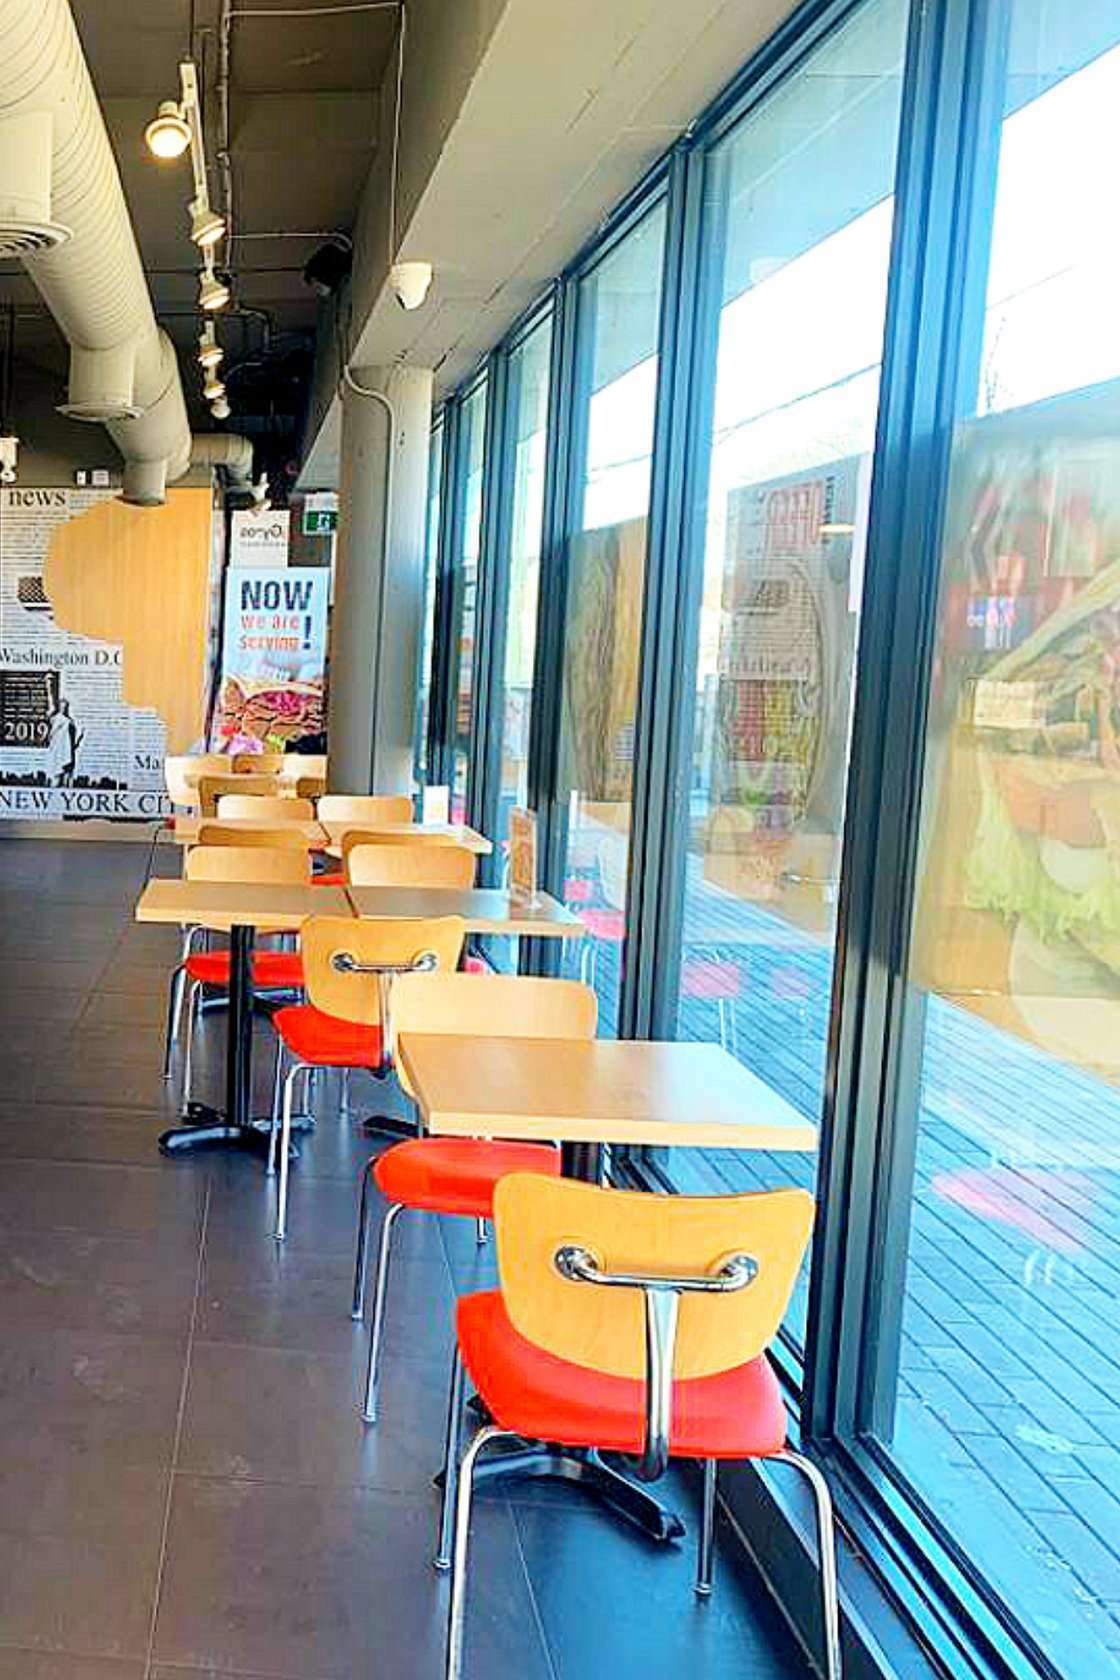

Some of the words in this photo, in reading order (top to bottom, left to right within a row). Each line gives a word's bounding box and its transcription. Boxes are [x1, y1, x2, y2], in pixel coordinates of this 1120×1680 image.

[9, 489, 67, 507] news
[241, 581, 313, 610] NOW
[272, 615, 301, 630] are
[0, 647, 89, 670] Washington
[3, 721, 49, 741] 2019
[61, 791, 129, 813] YORK
